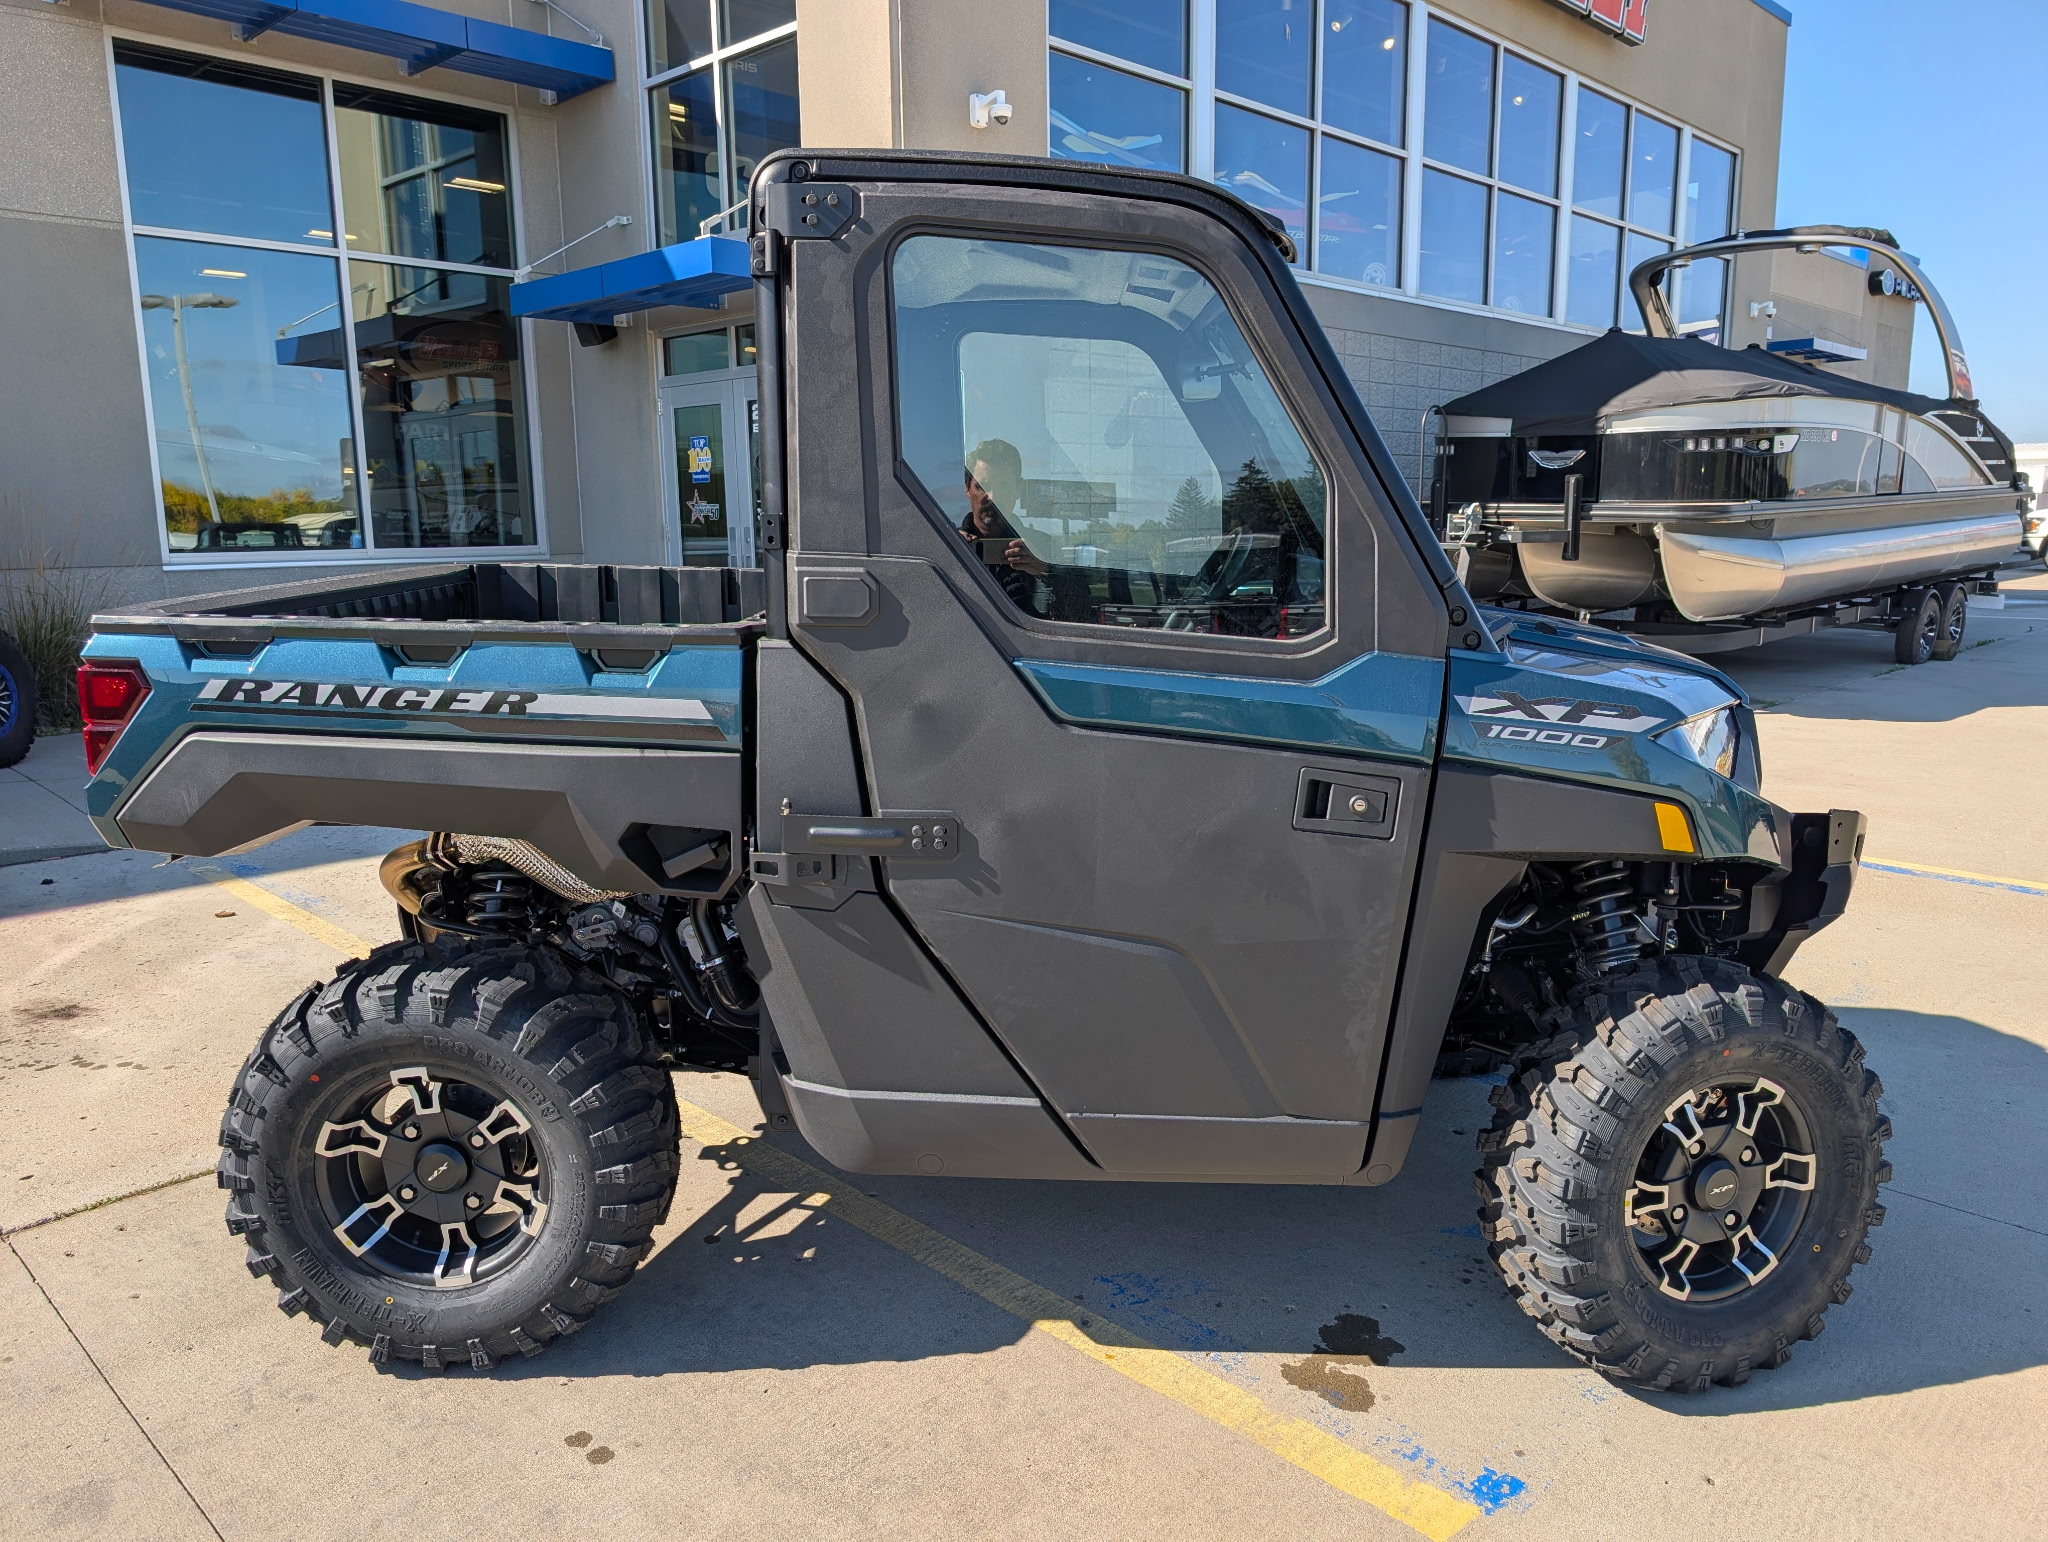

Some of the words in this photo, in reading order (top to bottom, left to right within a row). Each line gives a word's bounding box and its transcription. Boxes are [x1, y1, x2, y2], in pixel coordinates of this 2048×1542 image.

[693, 439, 706, 448] TOP
[688, 447, 712, 473] 100
[710, 507, 719, 520] 50
[213, 678, 538, 716] RANGER
[1471, 690, 1643, 724] XP
[1486, 724, 1608, 749] 1000
[423, 1035, 469, 1057] PRO
[472, 1049, 547, 1108] ARMOR
[1750, 1041, 1849, 1113] X-TERRAIN
[428, 1162, 448, 1181] XP
[1709, 1184, 1734, 1195] XP
[291, 1247, 428, 1334] X-TERRAIN
